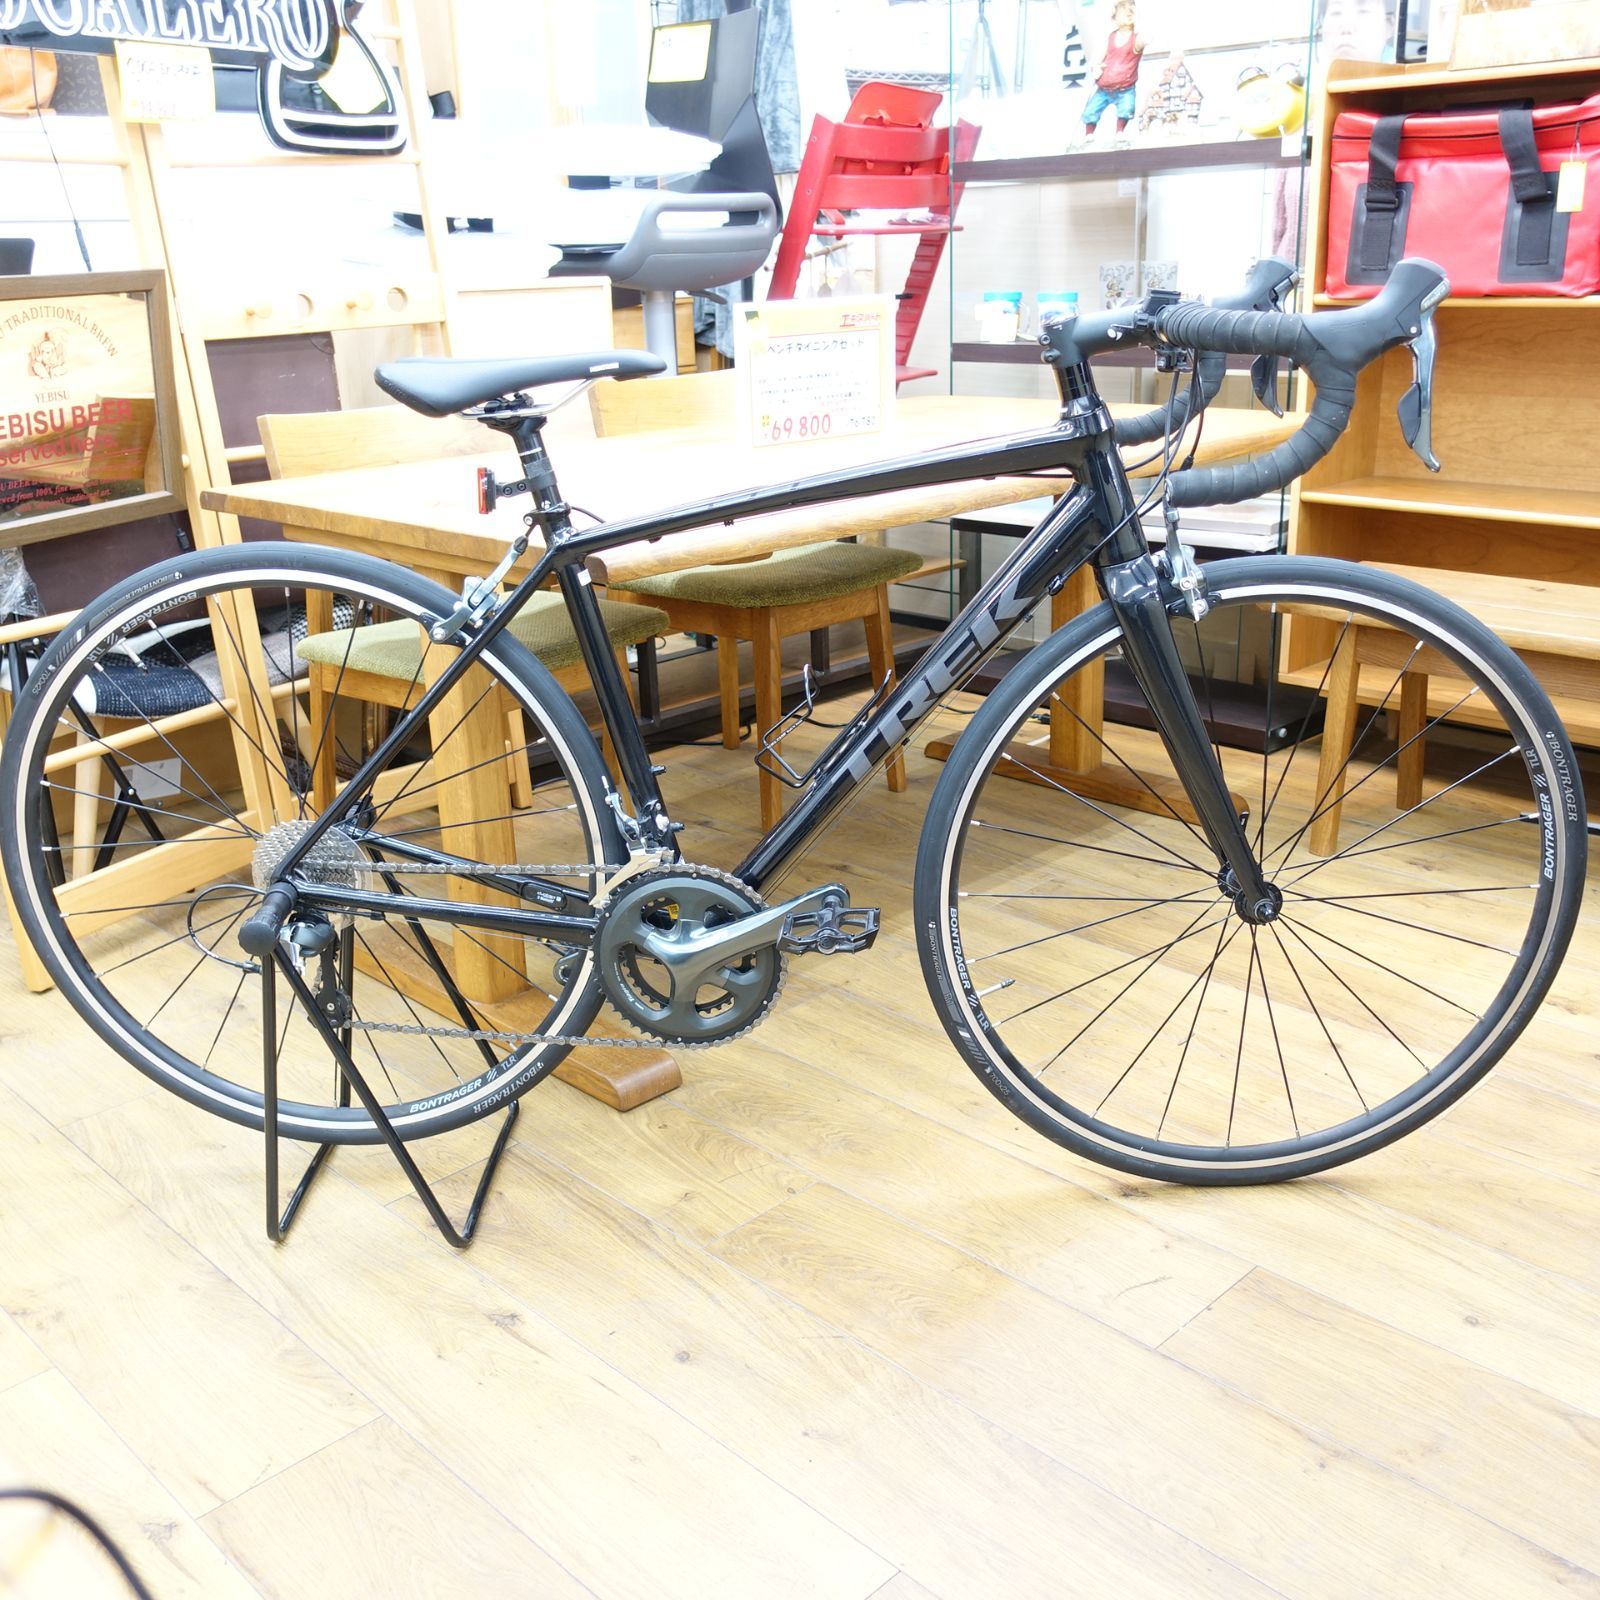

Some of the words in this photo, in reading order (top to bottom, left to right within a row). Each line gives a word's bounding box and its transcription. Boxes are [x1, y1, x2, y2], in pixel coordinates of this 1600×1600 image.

[5, 305, 89, 331] TRADITIONAL
[90, 322, 118, 357] BREW
[35, 389, 70, 404] YEBISU
[71, 397, 132, 430] BEER
[0, 436, 67, 467] served
[121, 590, 198, 633] BONTRAGER
[124, 575, 174, 601] BONTRAGER
[86, 646, 106, 663] TLR
[829, 573, 1037, 784] TREK
[1549, 740, 1579, 822] BONTRAGER
[1540, 792, 1555, 880] BONTRAGER
[929, 934, 943, 981] BONTRAGER
[949, 906, 972, 990] BONTRAGER
[975, 1009, 991, 1033] TLR
[409, 1077, 482, 1114] BONTRAGER
[501, 1054, 518, 1071] TLR
[473, 1066, 539, 1115] BONTRAGER
